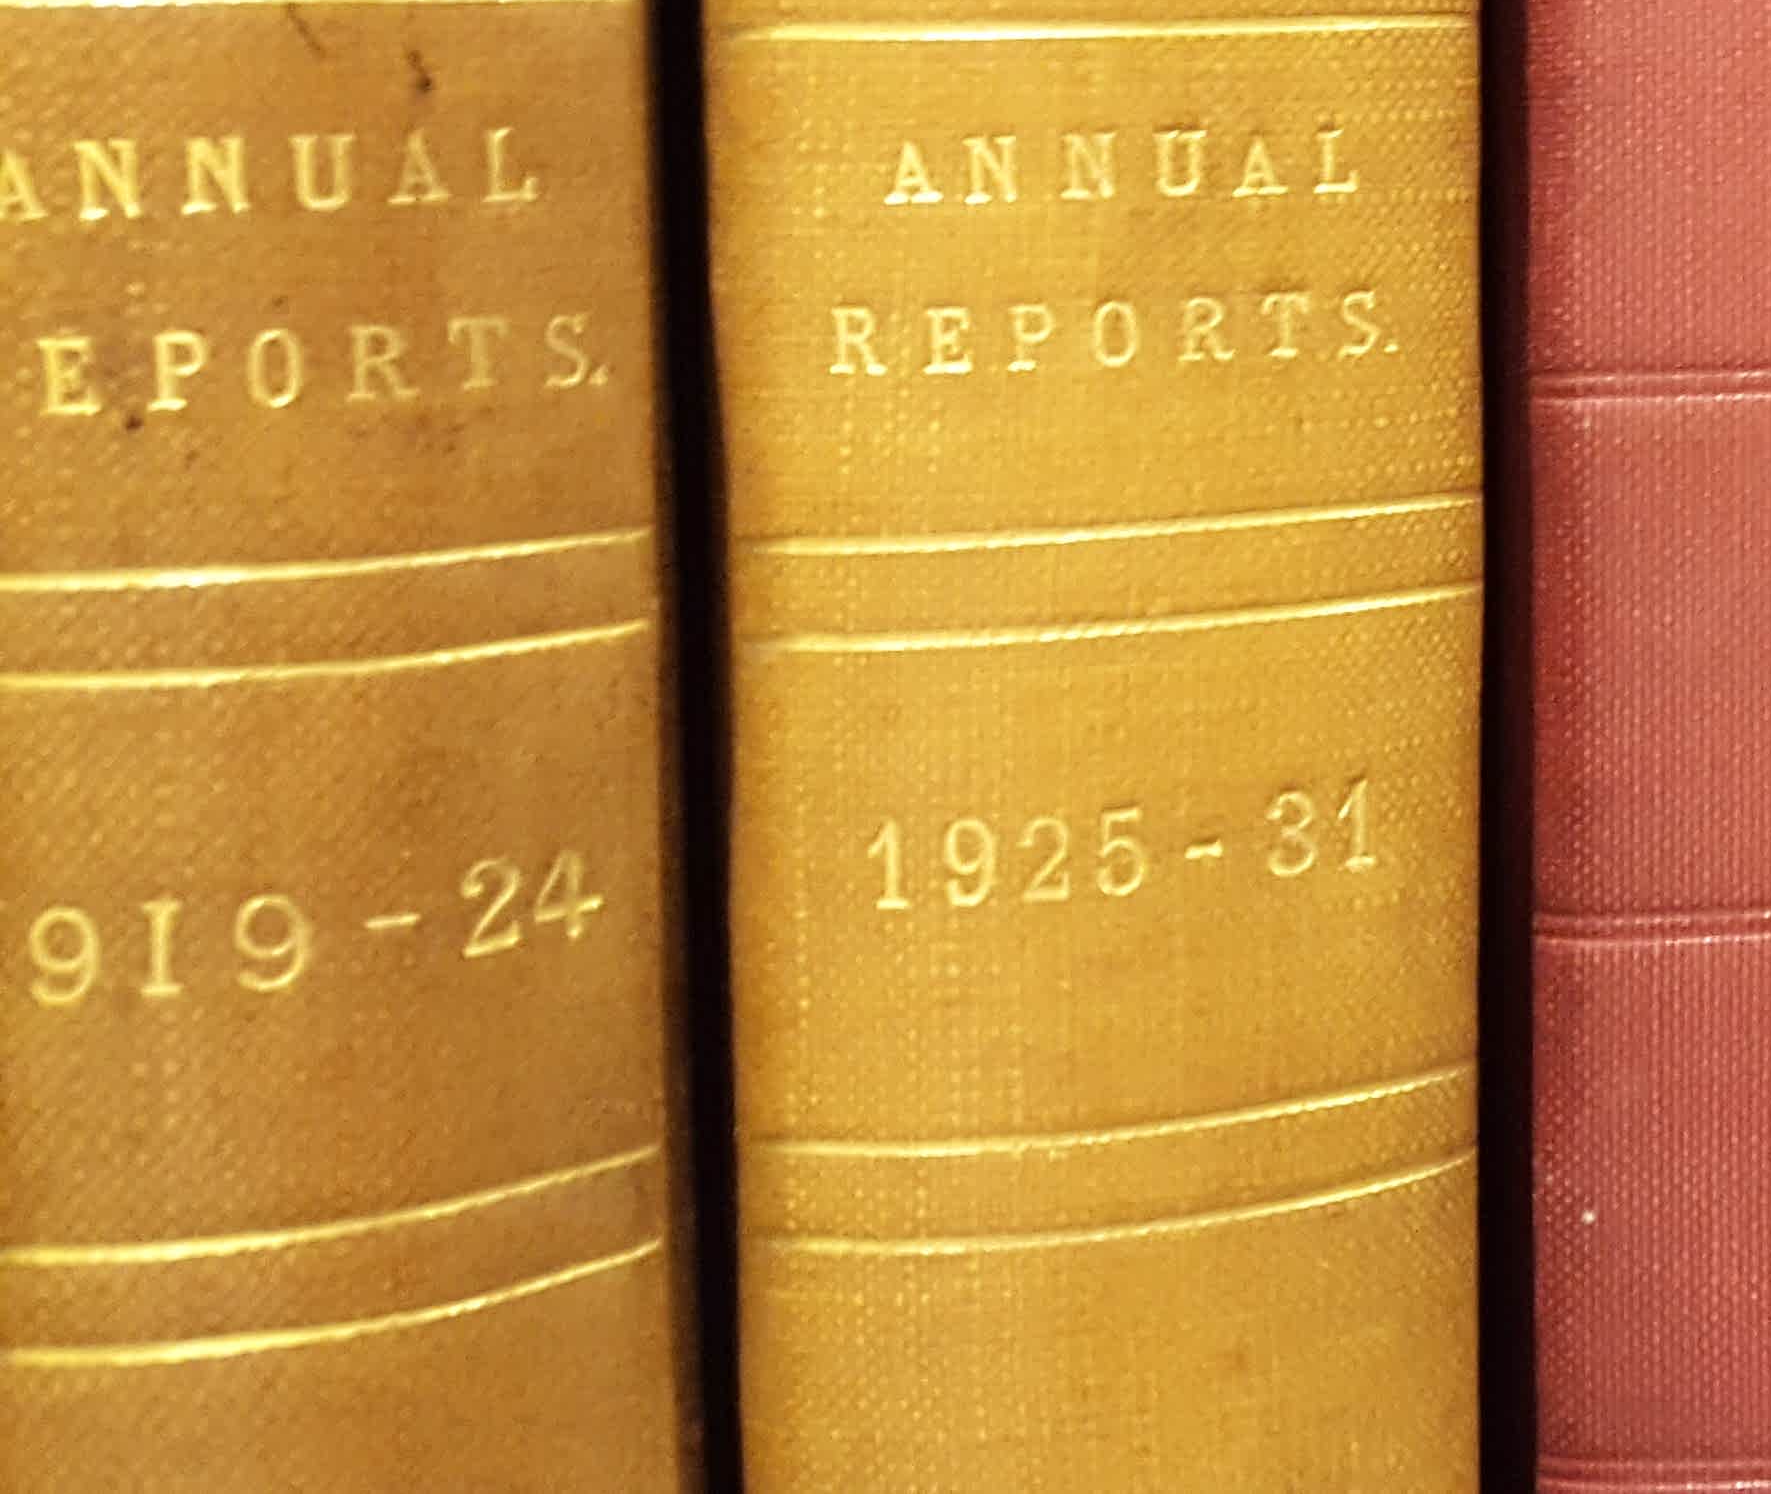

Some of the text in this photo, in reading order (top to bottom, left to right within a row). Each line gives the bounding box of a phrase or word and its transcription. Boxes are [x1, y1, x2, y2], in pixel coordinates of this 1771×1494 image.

[0, 126, 539, 222] ANNUAL
[883, 128, 1361, 205] ANNUAL
[37, 312, 608, 418] EPORTS.
[828, 290, 1401, 377] REPORTS.
